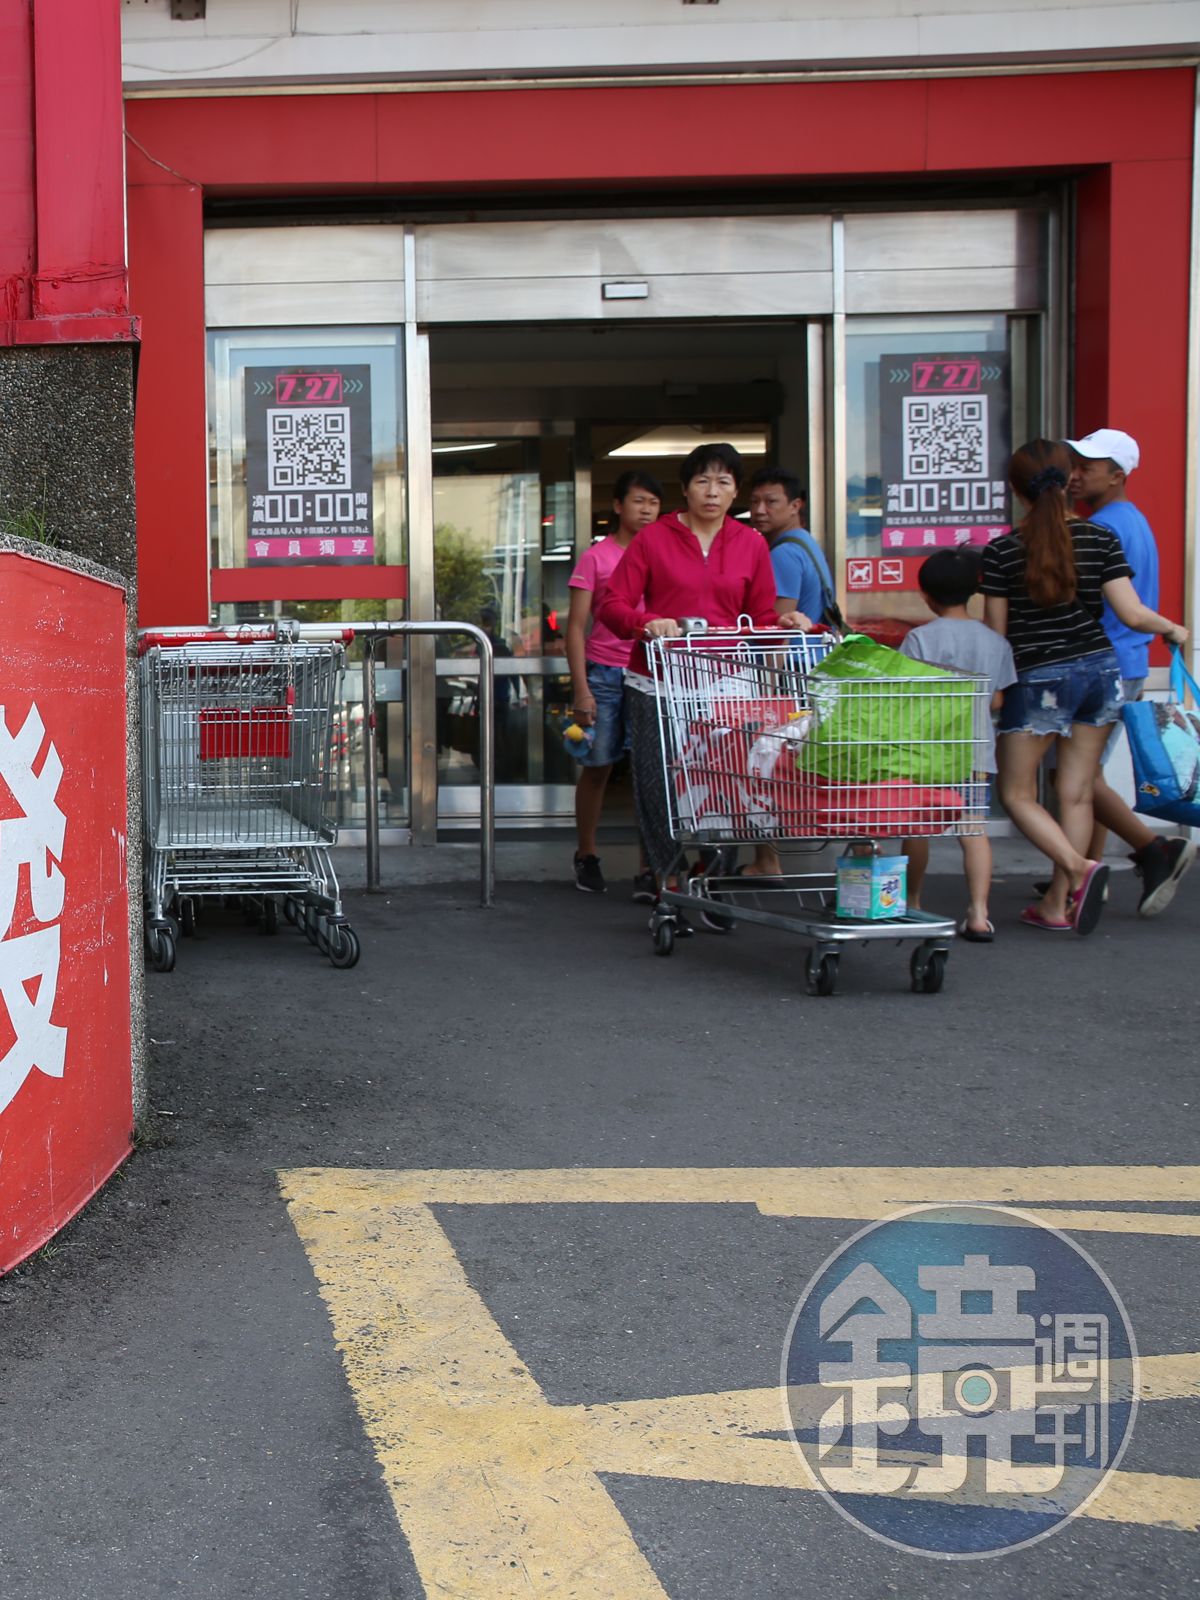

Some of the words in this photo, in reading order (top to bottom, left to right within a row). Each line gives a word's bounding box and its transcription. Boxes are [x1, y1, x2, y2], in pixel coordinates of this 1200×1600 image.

[265, 493, 354, 522] 00:00
[900, 482, 990, 512] 00:00
[255, 539, 368, 557] 會員獨享
